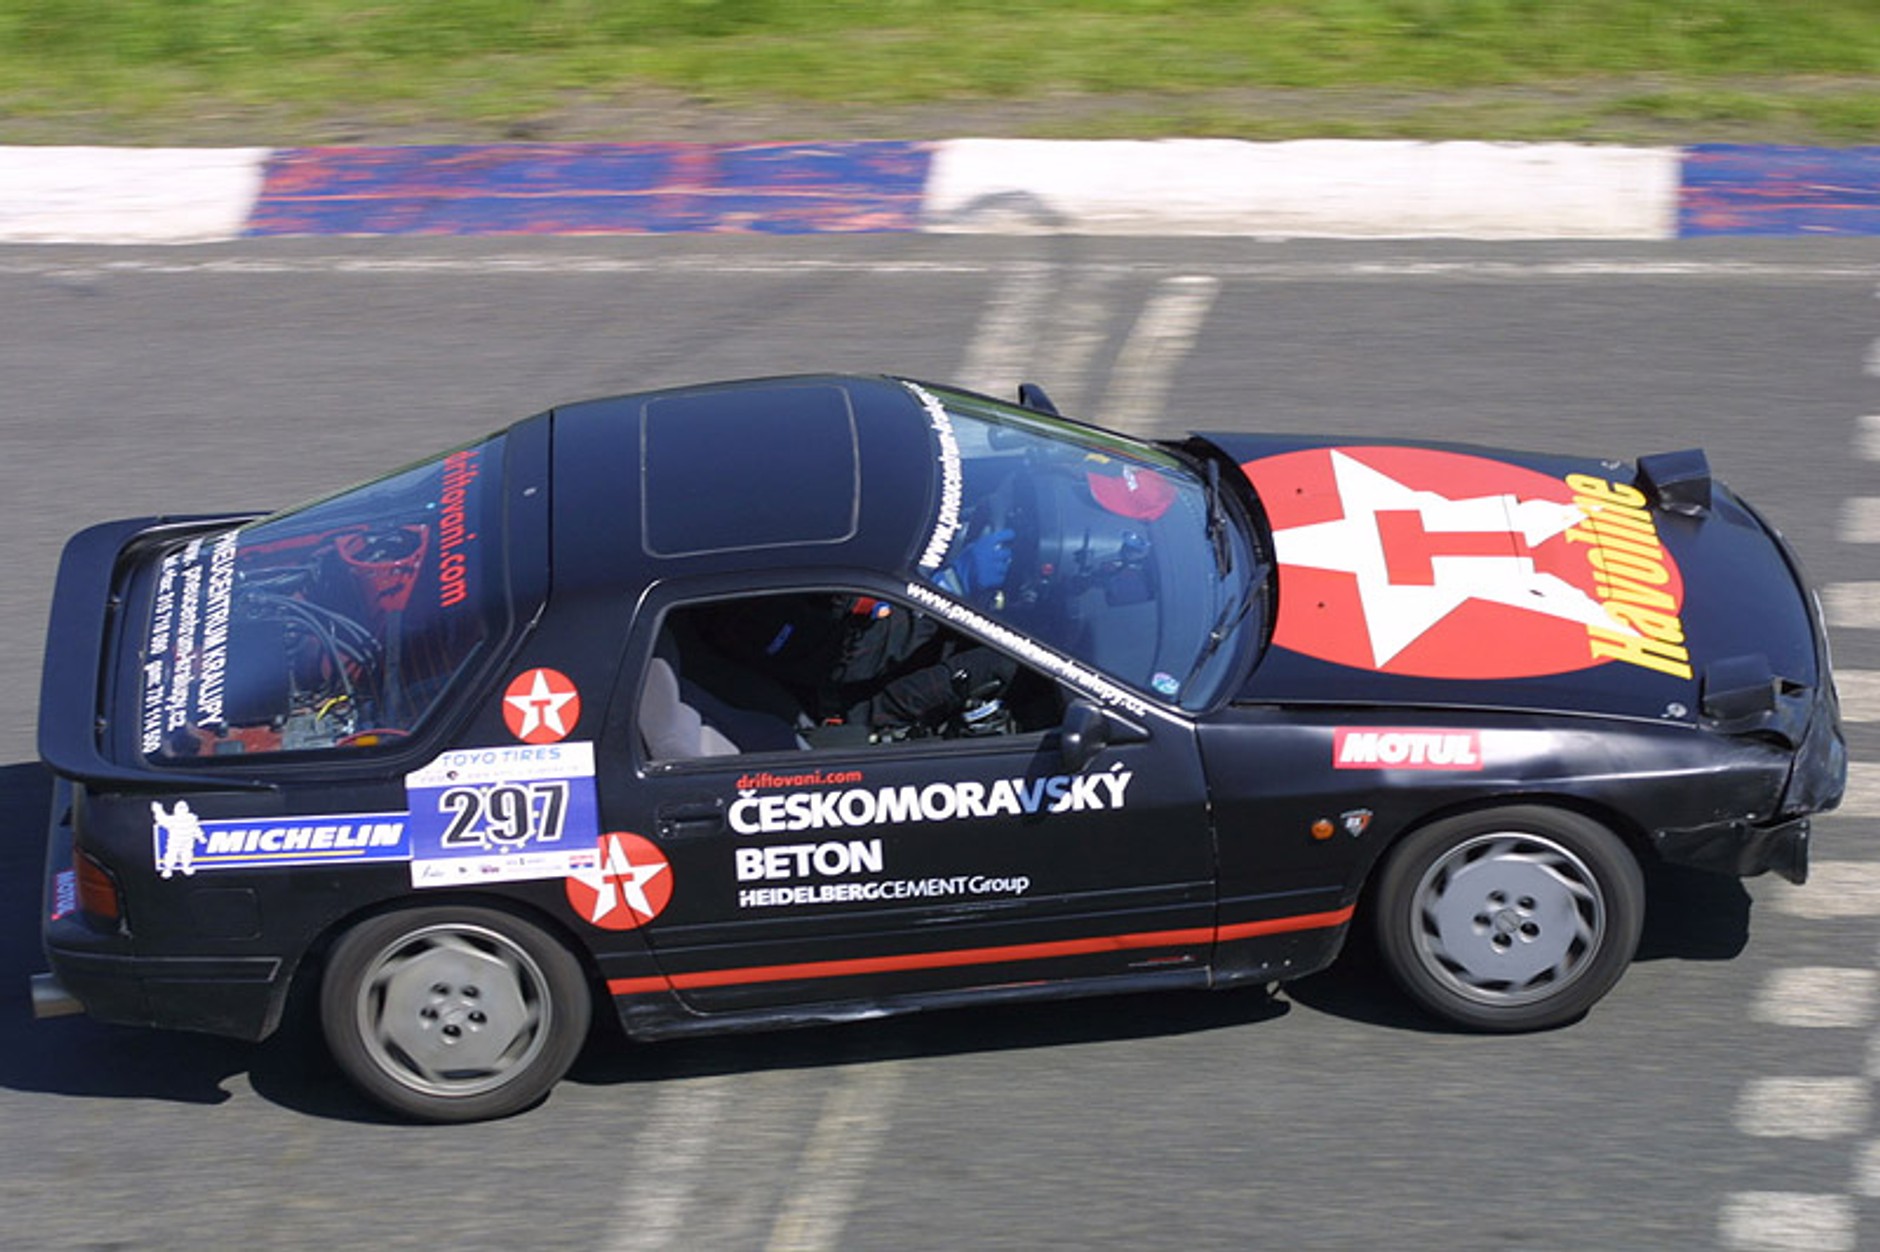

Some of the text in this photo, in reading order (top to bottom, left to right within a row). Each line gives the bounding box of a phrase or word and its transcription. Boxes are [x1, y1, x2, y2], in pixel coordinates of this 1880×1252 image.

[1565, 473, 1693, 680] Havoline
[197, 529, 239, 727] PNEUCENTRUM KRALUPY
[441, 747, 562, 768] TOYO TIRES
[1339, 732, 1477, 766] MOTUL
[728, 761, 1133, 835] ČESKOMORAVSKÝ
[735, 769, 862, 790] driftovani.com
[440, 783, 568, 846] 297
[206, 822, 404, 854] MICHELIN
[735, 838, 884, 881] BETON
[739, 874, 1030, 908] HEIDELBERGCEMENT Group
